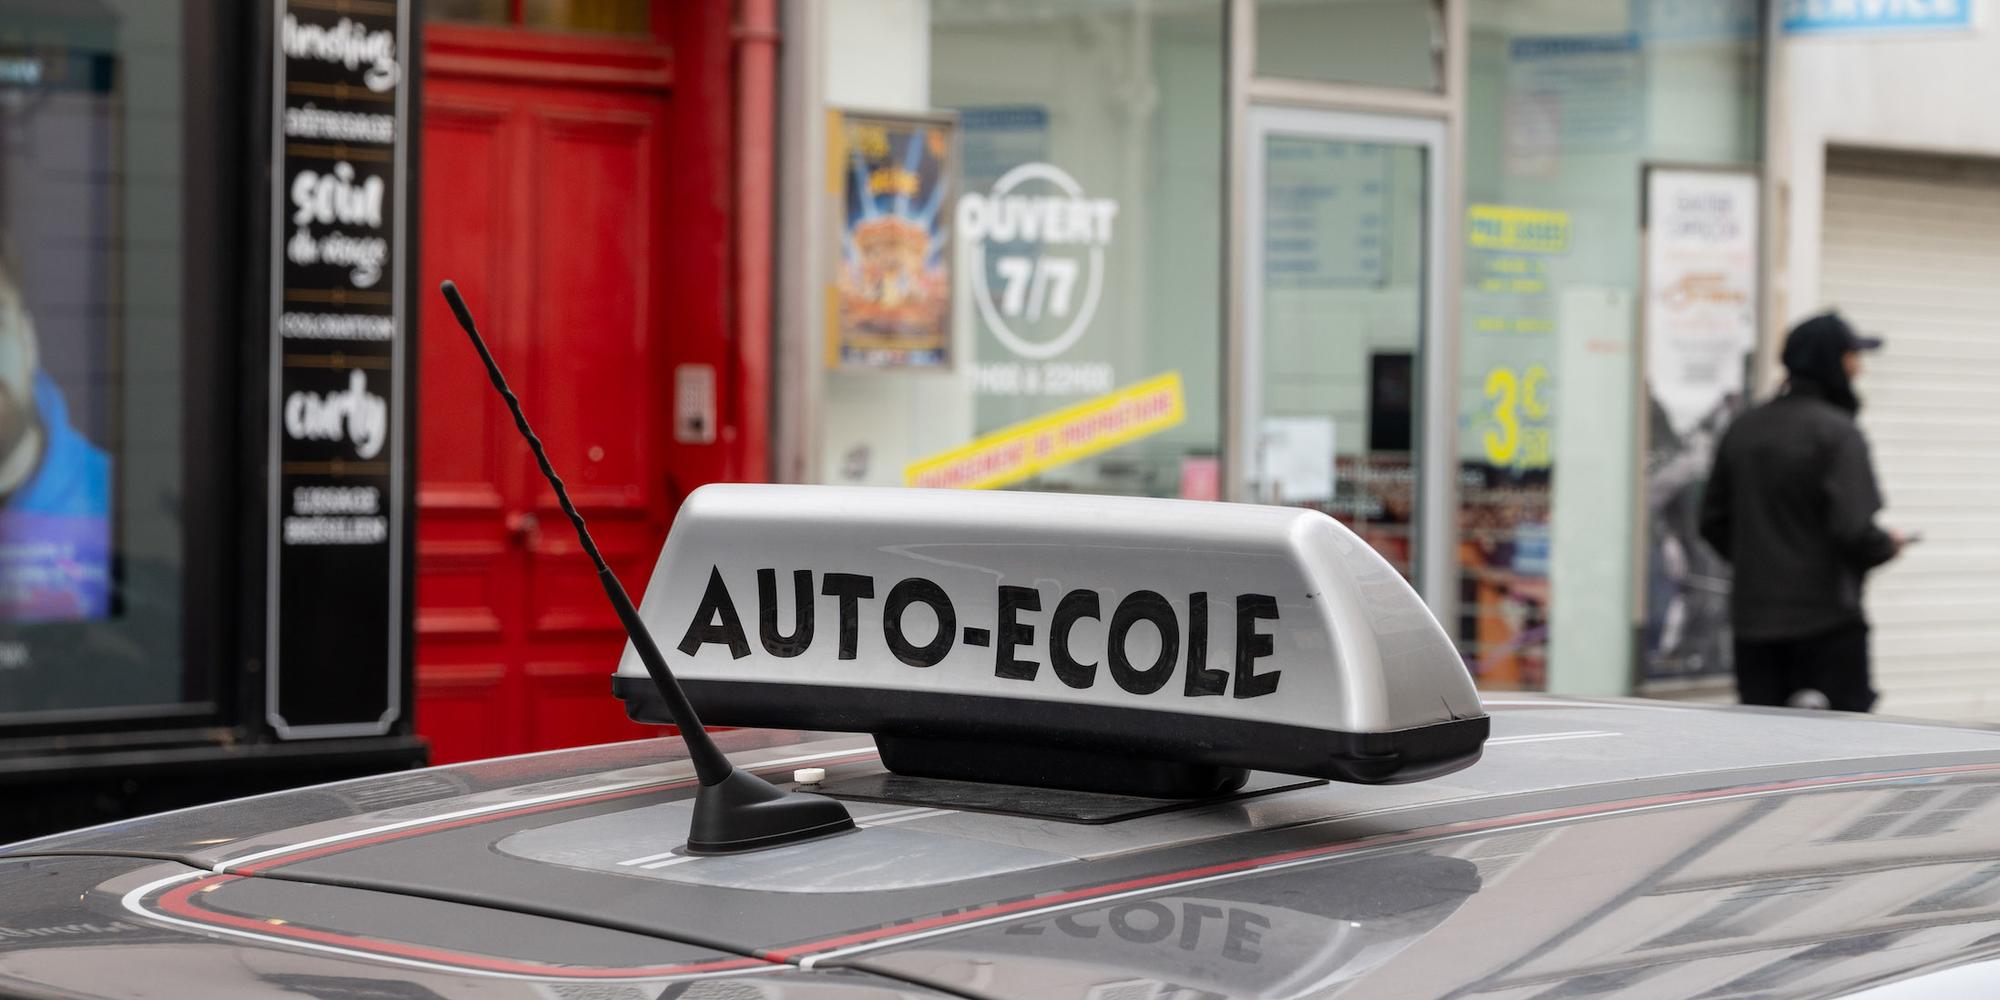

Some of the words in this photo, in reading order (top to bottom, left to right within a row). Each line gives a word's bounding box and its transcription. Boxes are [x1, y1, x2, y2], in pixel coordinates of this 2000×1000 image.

[291, 161, 384, 227] soin
[957, 192, 1119, 244] OUVERT
[997, 258, 1079, 322] 7/7
[285, 369, 387, 458] curly
[677, 564, 1282, 699] AUTO-ECOLE
